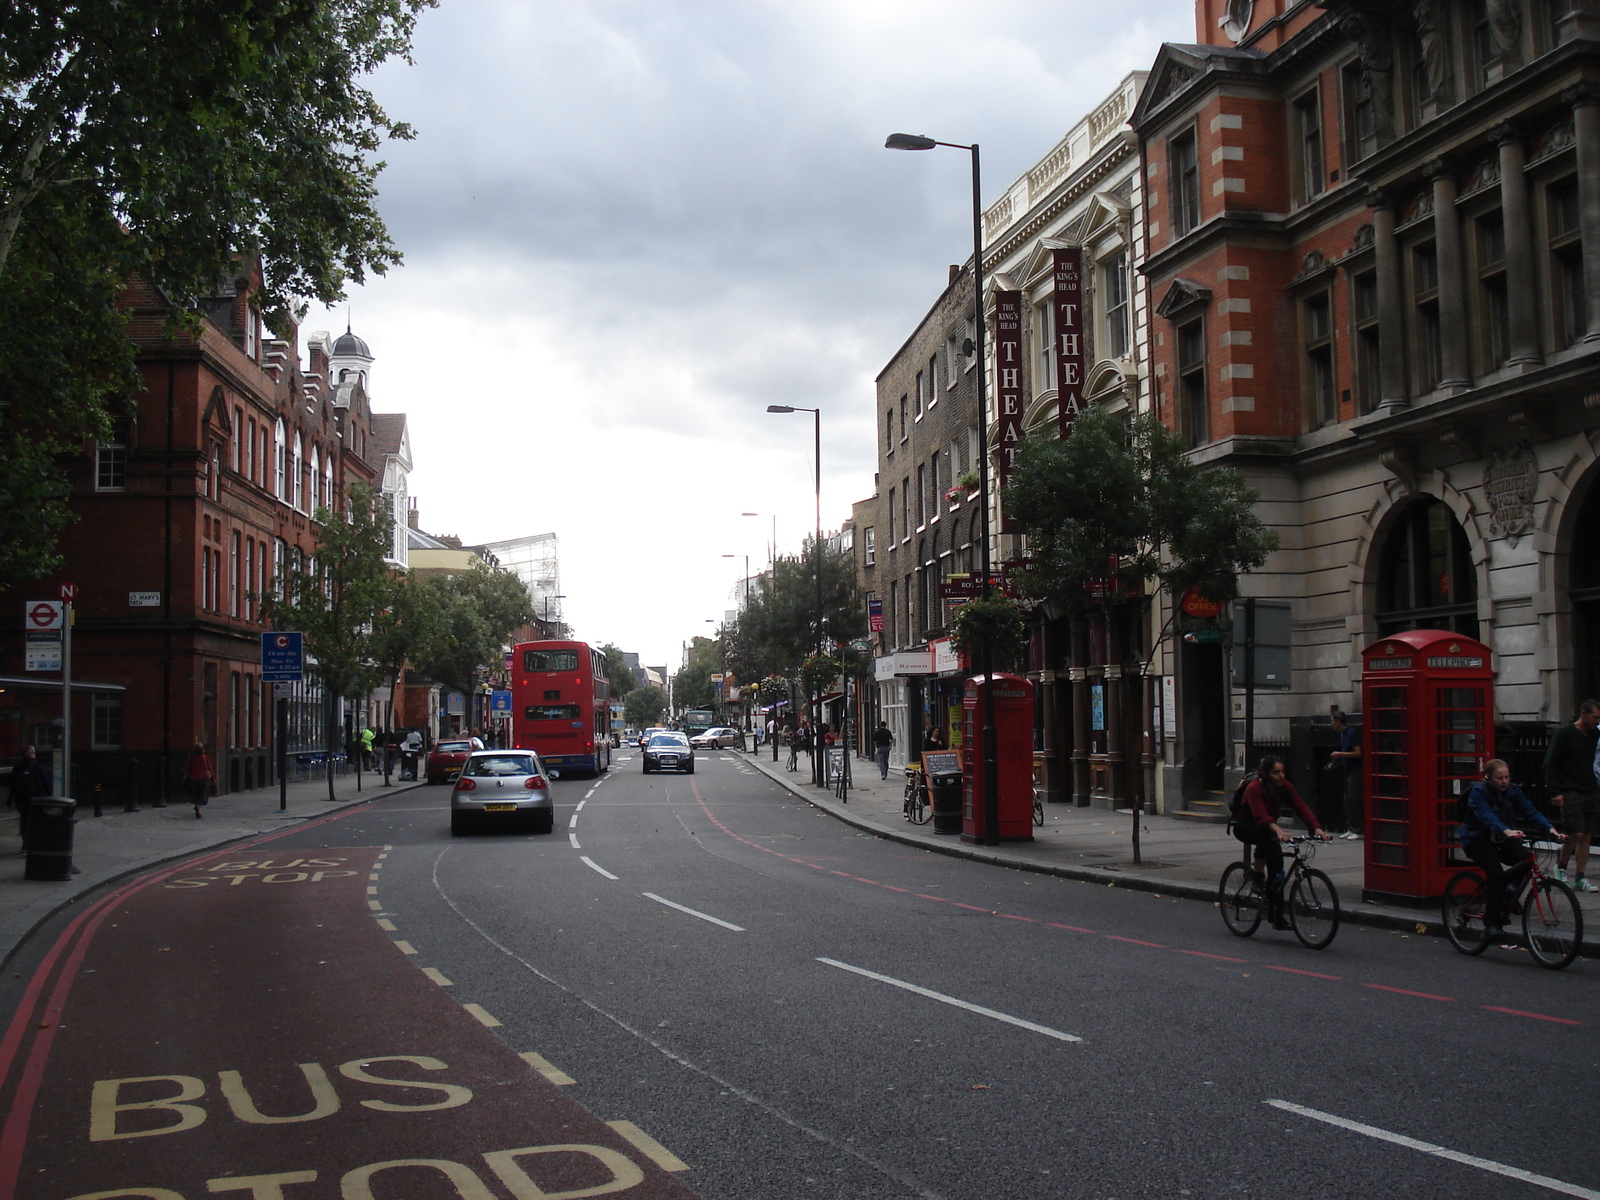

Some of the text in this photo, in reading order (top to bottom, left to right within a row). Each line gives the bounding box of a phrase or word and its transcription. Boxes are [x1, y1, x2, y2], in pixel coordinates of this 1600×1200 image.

[1060, 262, 1074, 271] THE
[1056, 270, 1079, 281] KING'S
[1058, 282, 1077, 291] HEAD
[1002, 303, 1015, 312] THE
[998, 311, 1019, 321] KING'S
[1000, 321, 1017, 330] HEAD
[1497, 489, 1520, 508] POST
[61, 585, 73, 597] N
[1187, 602, 1217, 611] OFFICE
[277, 636, 287, 647] C
[1429, 657, 1482, 667] TELEPHO
[208, 858, 347, 872] BUS
[164, 870, 358, 888] STOP
[89, 1055, 473, 1142] BUS
